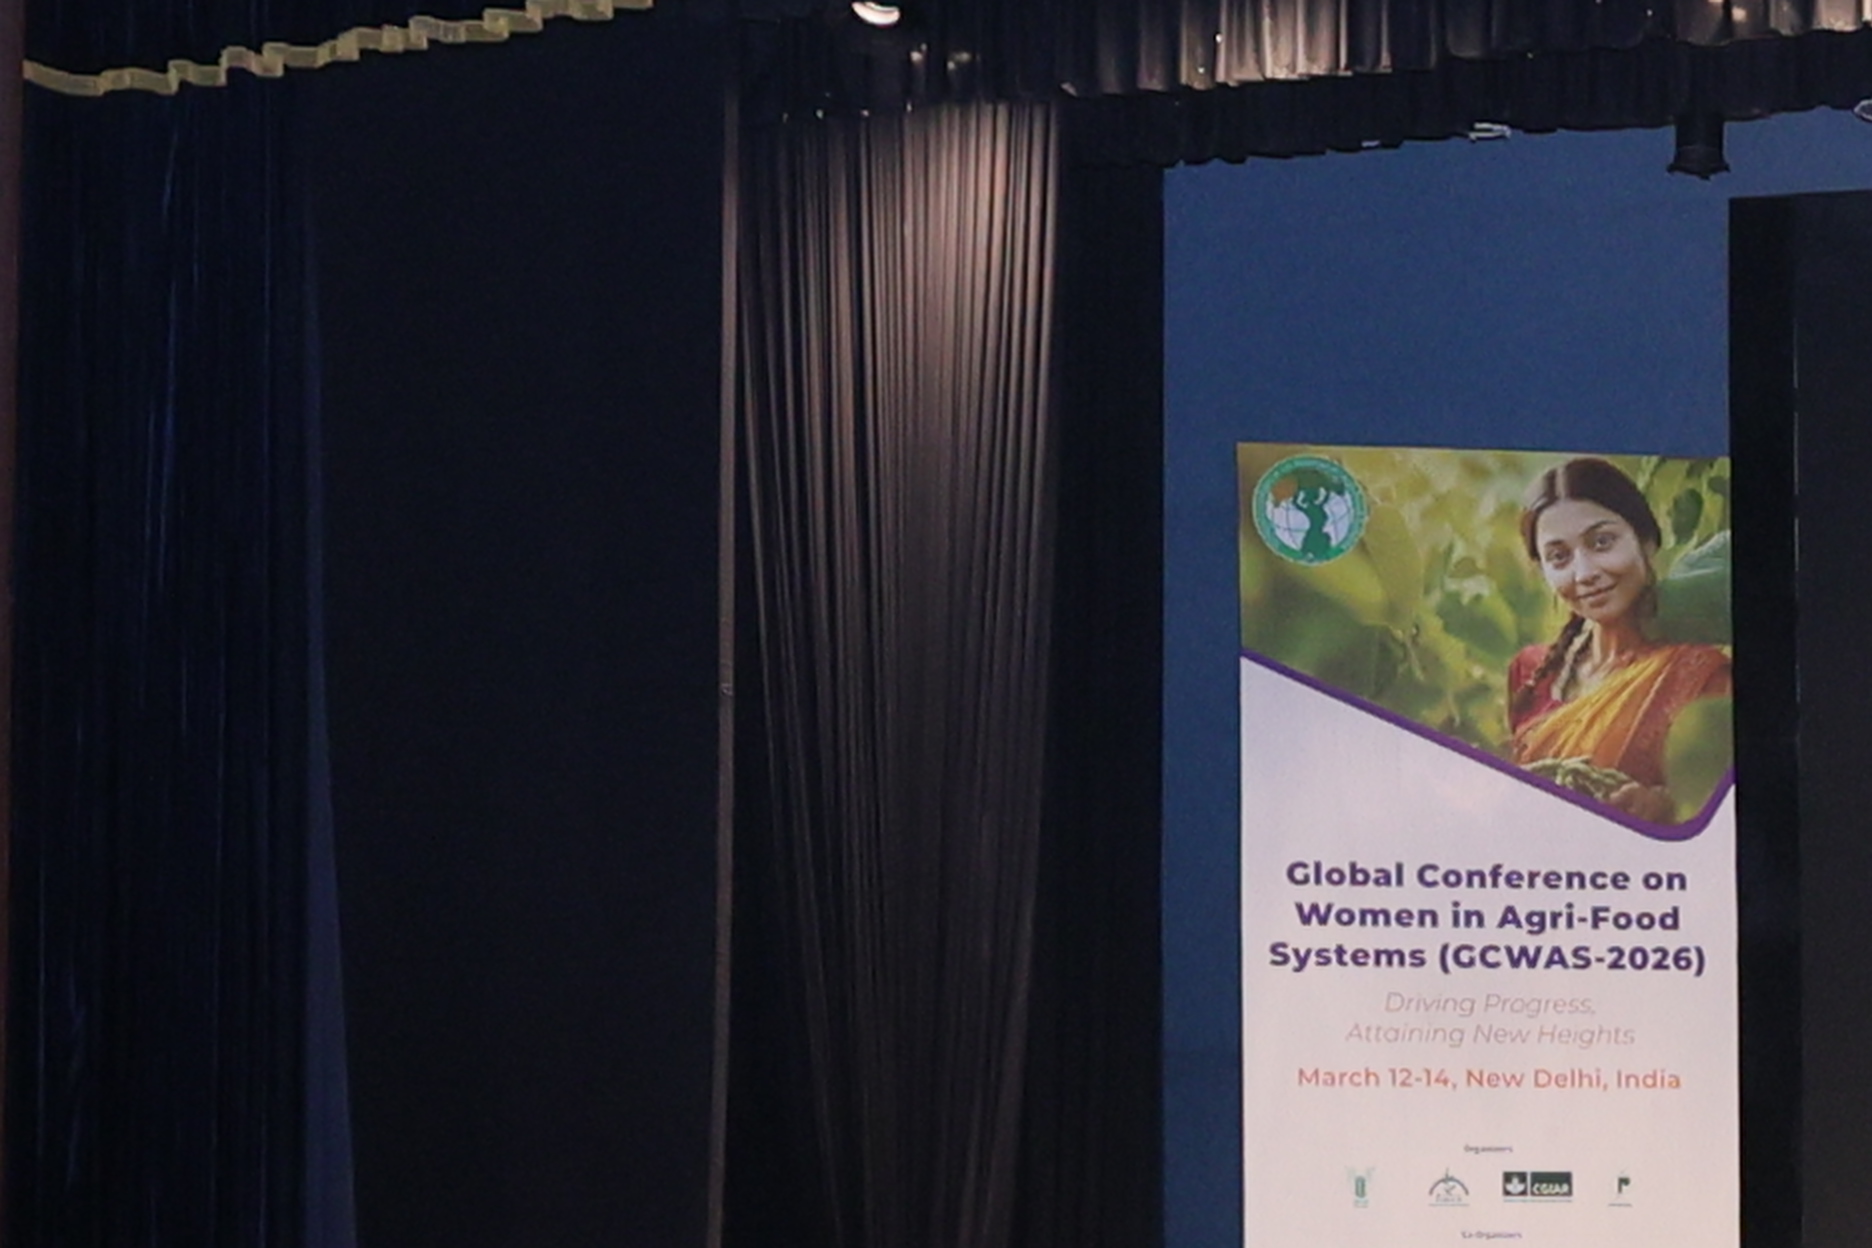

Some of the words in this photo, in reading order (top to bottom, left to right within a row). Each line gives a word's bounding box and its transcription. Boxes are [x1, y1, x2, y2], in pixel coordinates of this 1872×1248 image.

[1286, 861, 1404, 888] Global
[1417, 863, 1630, 891] Conference
[1642, 871, 1687, 891] on
[1295, 902, 1439, 928] Women
[1452, 902, 1485, 928] in
[1497, 903, 1680, 935] Agri-Food
[1269, 942, 1427, 973] Systems
[1439, 943, 1706, 977] (GCWAS-2026)
[1384, 992, 1475, 1017] Driving
[1484, 994, 1596, 1019] Progress,
[1345, 1023, 1465, 1048] Attaining
[1473, 1025, 1529, 1045] New
[1537, 1025, 1636, 1049] Heights
[1298, 1067, 1379, 1088] March
[1388, 1068, 1457, 1090] 12-14,
[1466, 1069, 1523, 1089] New
[1534, 1069, 1608, 1092] Delhi,
[1617, 1070, 1681, 1089] India
